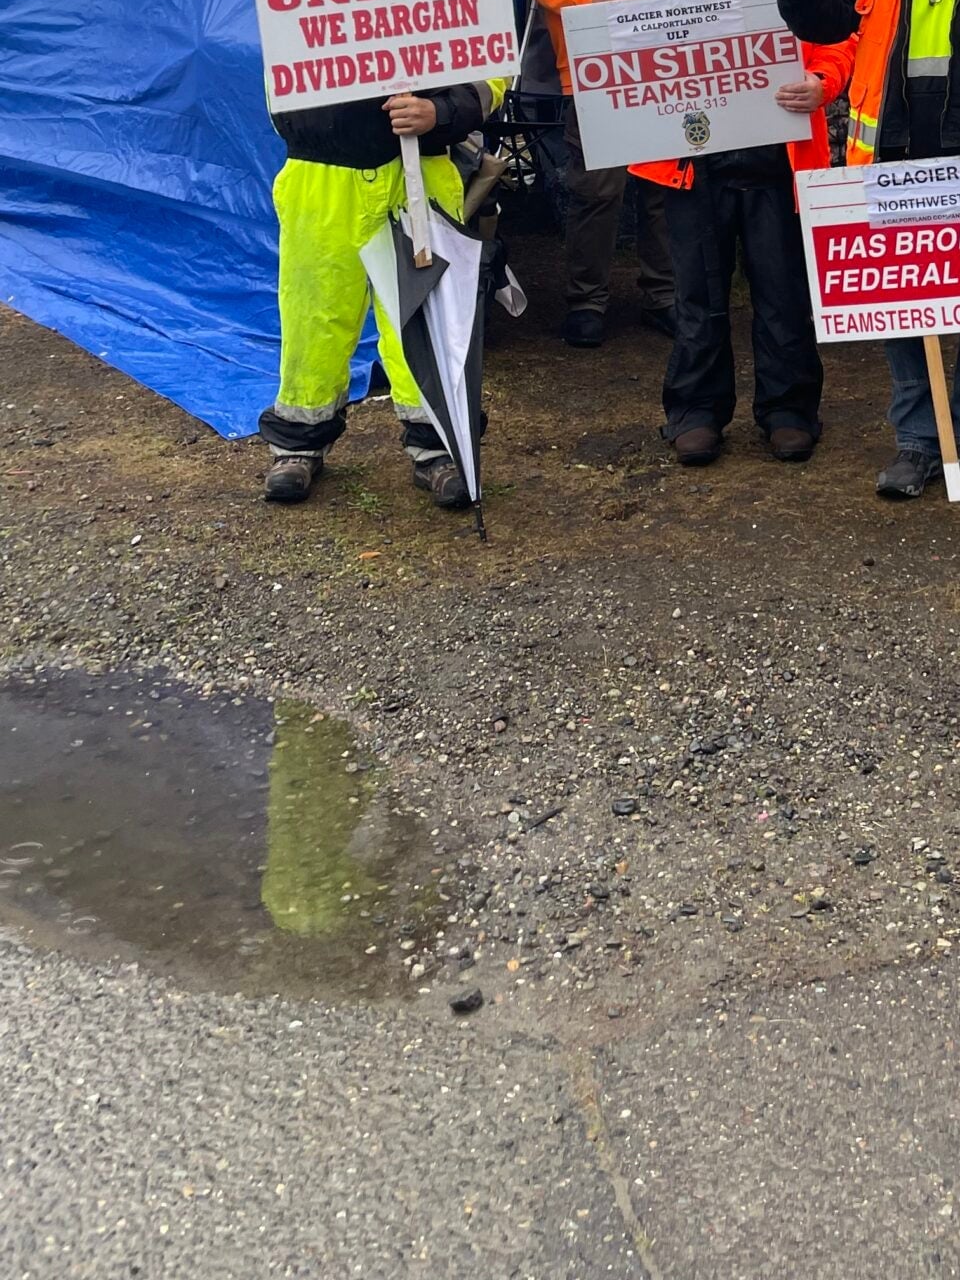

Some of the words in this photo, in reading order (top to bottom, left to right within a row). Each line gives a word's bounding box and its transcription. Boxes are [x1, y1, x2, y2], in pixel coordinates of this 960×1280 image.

[617, 10, 663, 24] GLACIER
[665, 1, 732, 17] NORTHWEST
[641, 17, 703, 31] CALPORTLAND
[705, 15, 720, 23] CO.
[299, 13, 347, 48] WE
[666, 30, 690, 41] ULP
[272, 50, 396, 97] DIVIDED
[399, 42, 444, 77] WE
[449, 32, 516, 70] BEG!
[577, 52, 642, 89] ON
[652, 31, 797, 79] STRIKE
[606, 69, 769, 109] TEAMSTERS
[657, 102, 701, 116] LOCAL
[704, 97, 728, 110] 313
[877, 166, 959, 187] GLACIER
[827, 235, 886, 261] HAS
[824, 261, 959, 294] FEDERAL
[821, 306, 936, 335] TEAMSTERS
